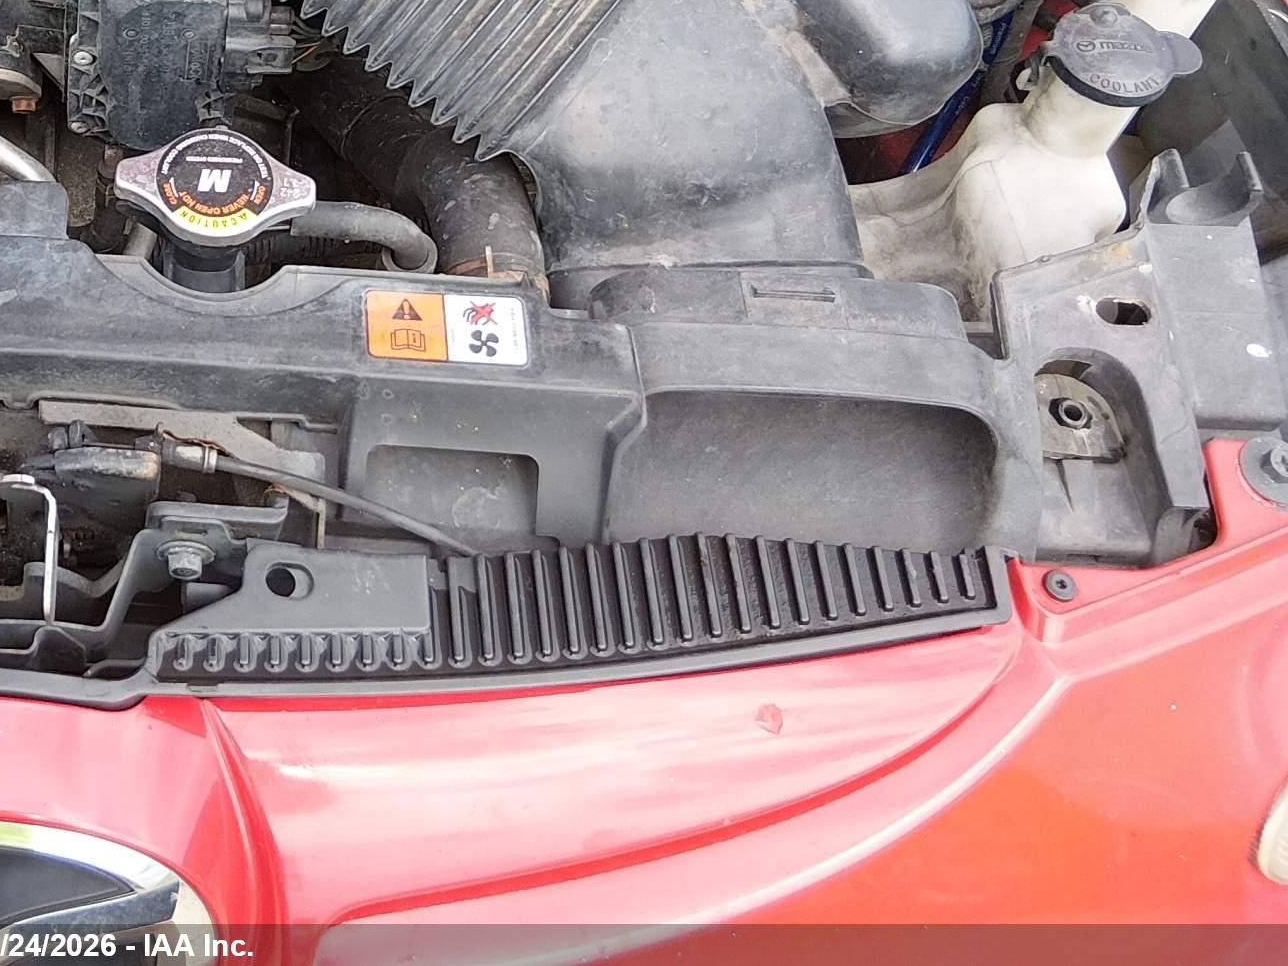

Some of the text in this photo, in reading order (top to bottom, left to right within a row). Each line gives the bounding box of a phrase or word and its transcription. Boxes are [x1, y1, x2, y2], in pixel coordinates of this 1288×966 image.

[1089, 73, 1160, 94] COOLANT
[197, 168, 232, 193] M
[179, 191, 250, 216] NEVER OPEN HOT
[179, 210, 238, 229] CAUTION
